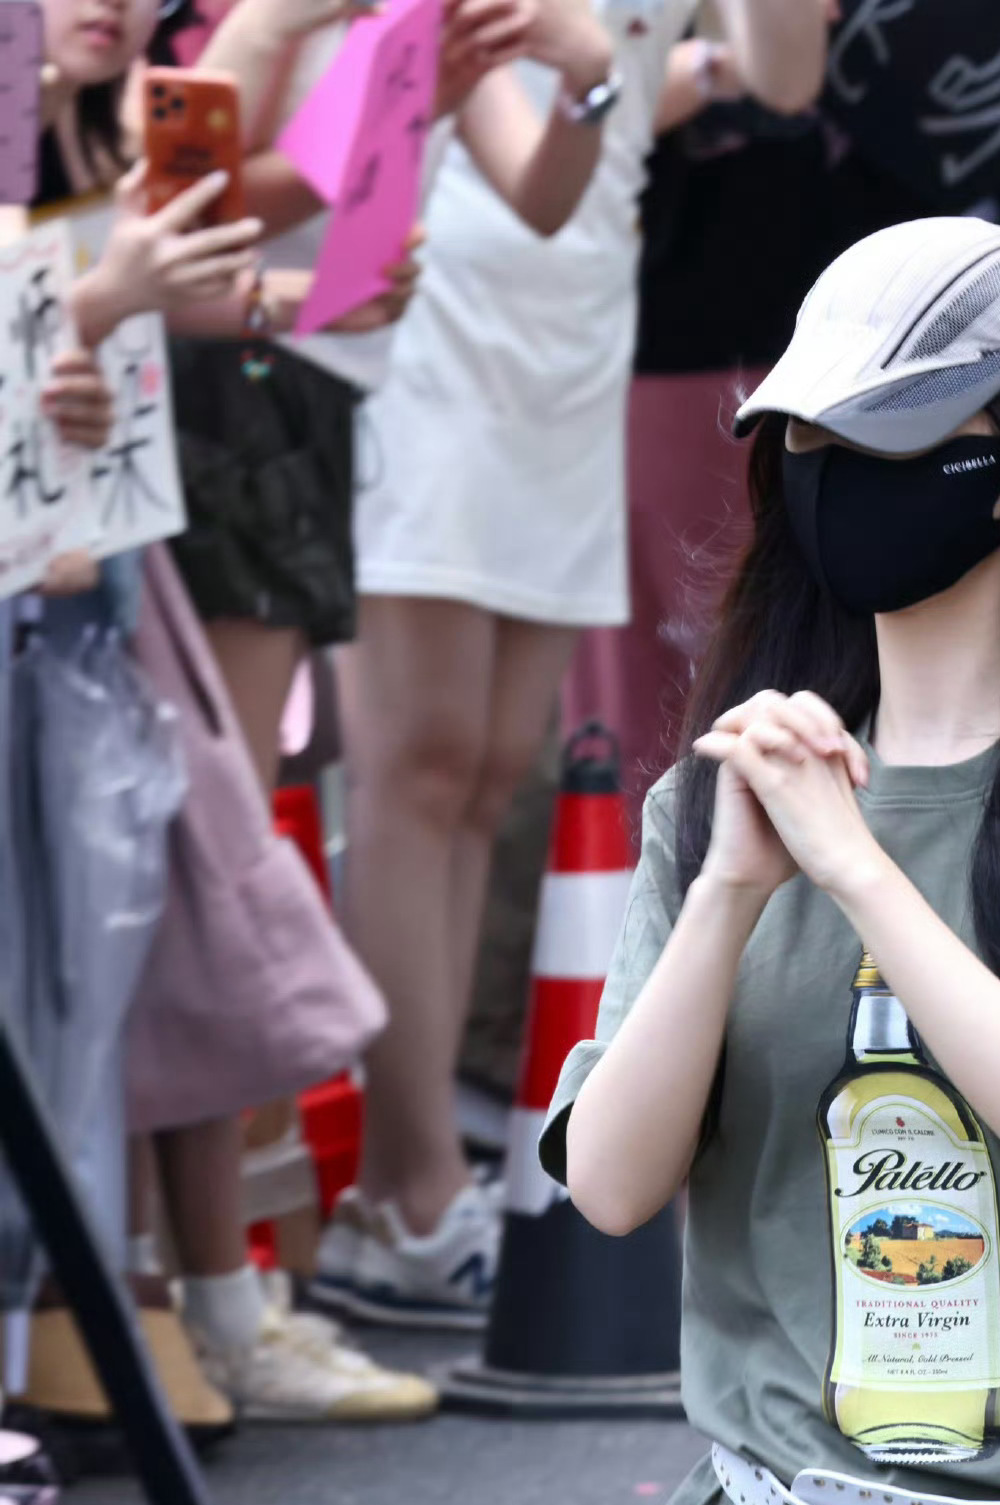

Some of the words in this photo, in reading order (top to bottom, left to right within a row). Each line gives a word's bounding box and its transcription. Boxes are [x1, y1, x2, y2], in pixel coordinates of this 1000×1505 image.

[943, 454, 996, 475] CICIBELLA
[856, 1299, 926, 1308] TRADITIONAL
[931, 1298, 979, 1309] QUALITY
[864, 1311, 910, 1328] Extra
[917, 1310, 970, 1332] Virgin
